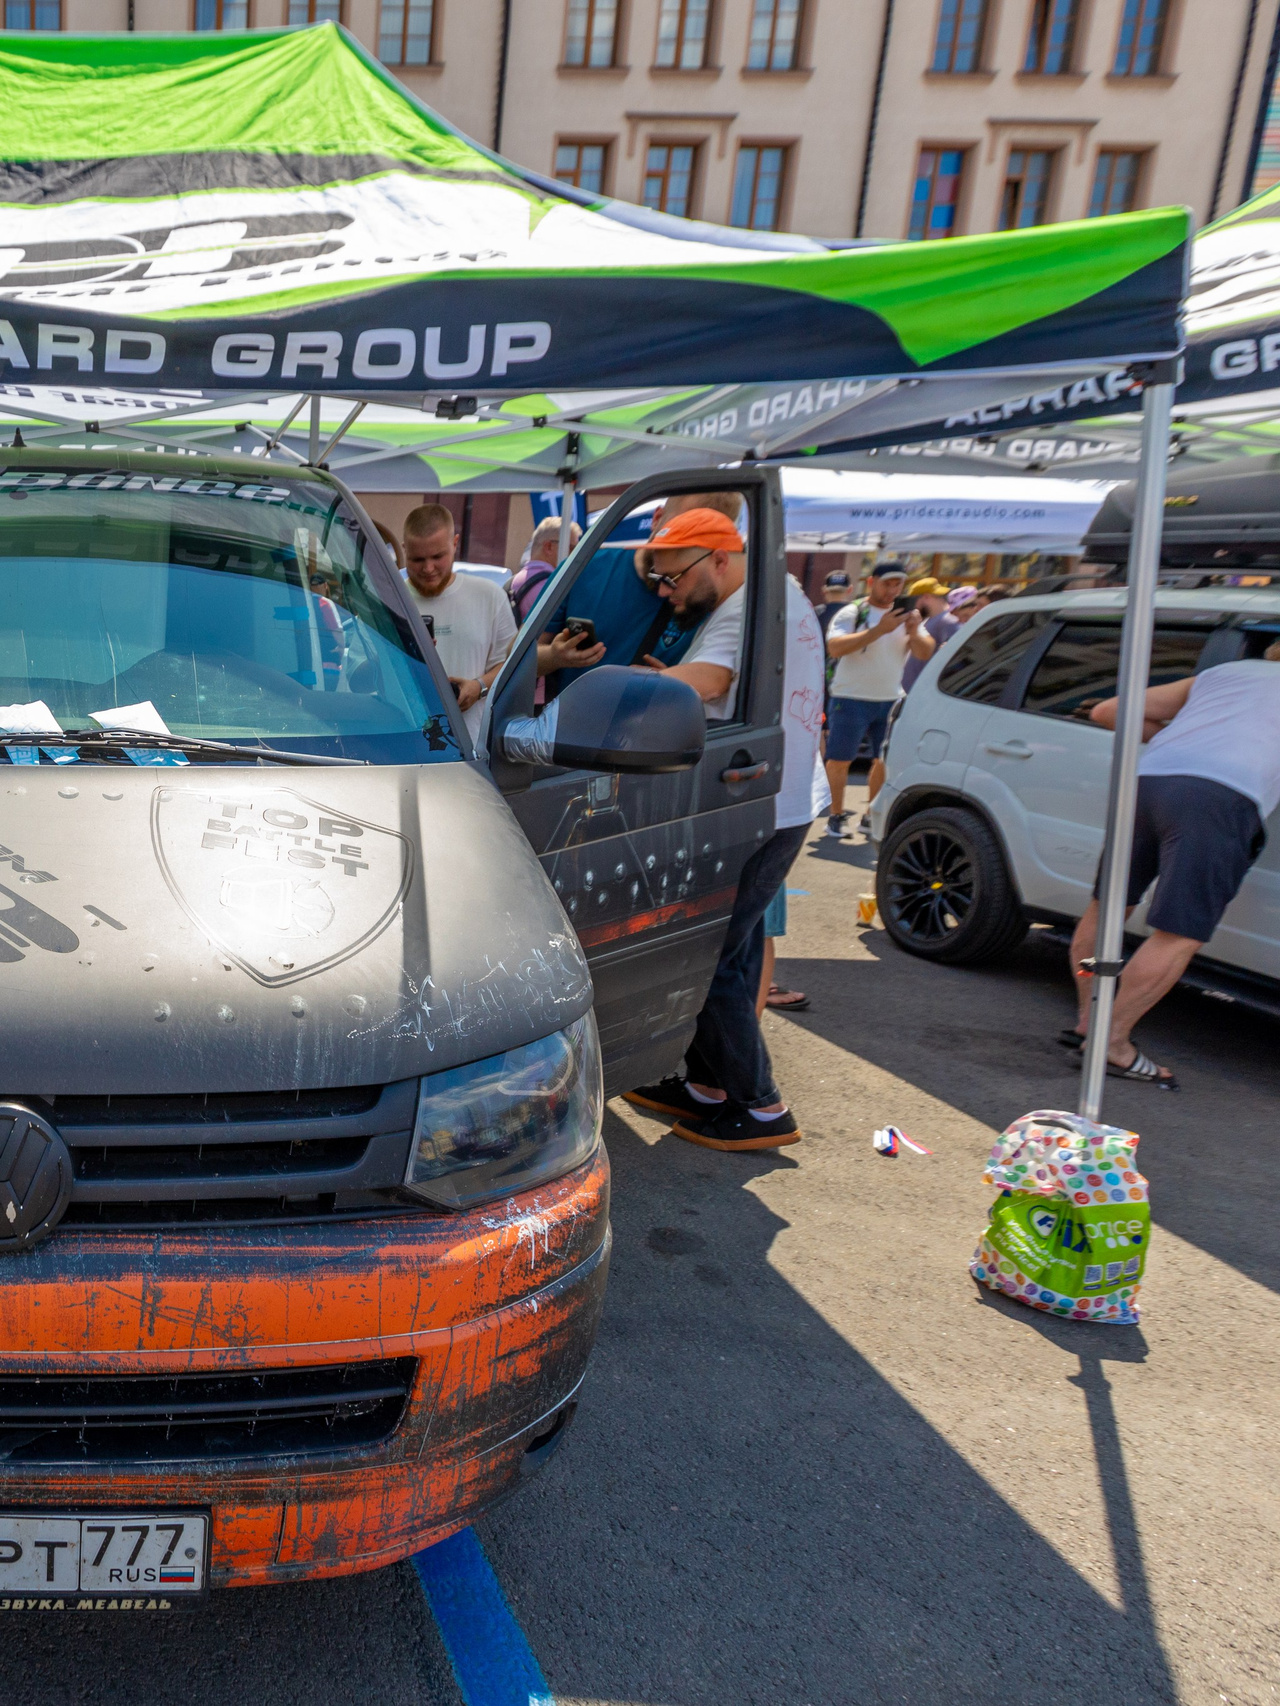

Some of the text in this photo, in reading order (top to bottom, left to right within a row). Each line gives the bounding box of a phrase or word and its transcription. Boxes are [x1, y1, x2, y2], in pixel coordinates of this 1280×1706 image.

[211, 321, 552, 381] GROUP
[944, 356, 1185, 429] ALPHAR
[851, 505, 1046, 521] www.pridecaraudio.com
[207, 818, 362, 858] BATTLE
[209, 795, 363, 838] TOP
[86, 1524, 185, 1567] 777
[109, 1568, 157, 1583] RUS
